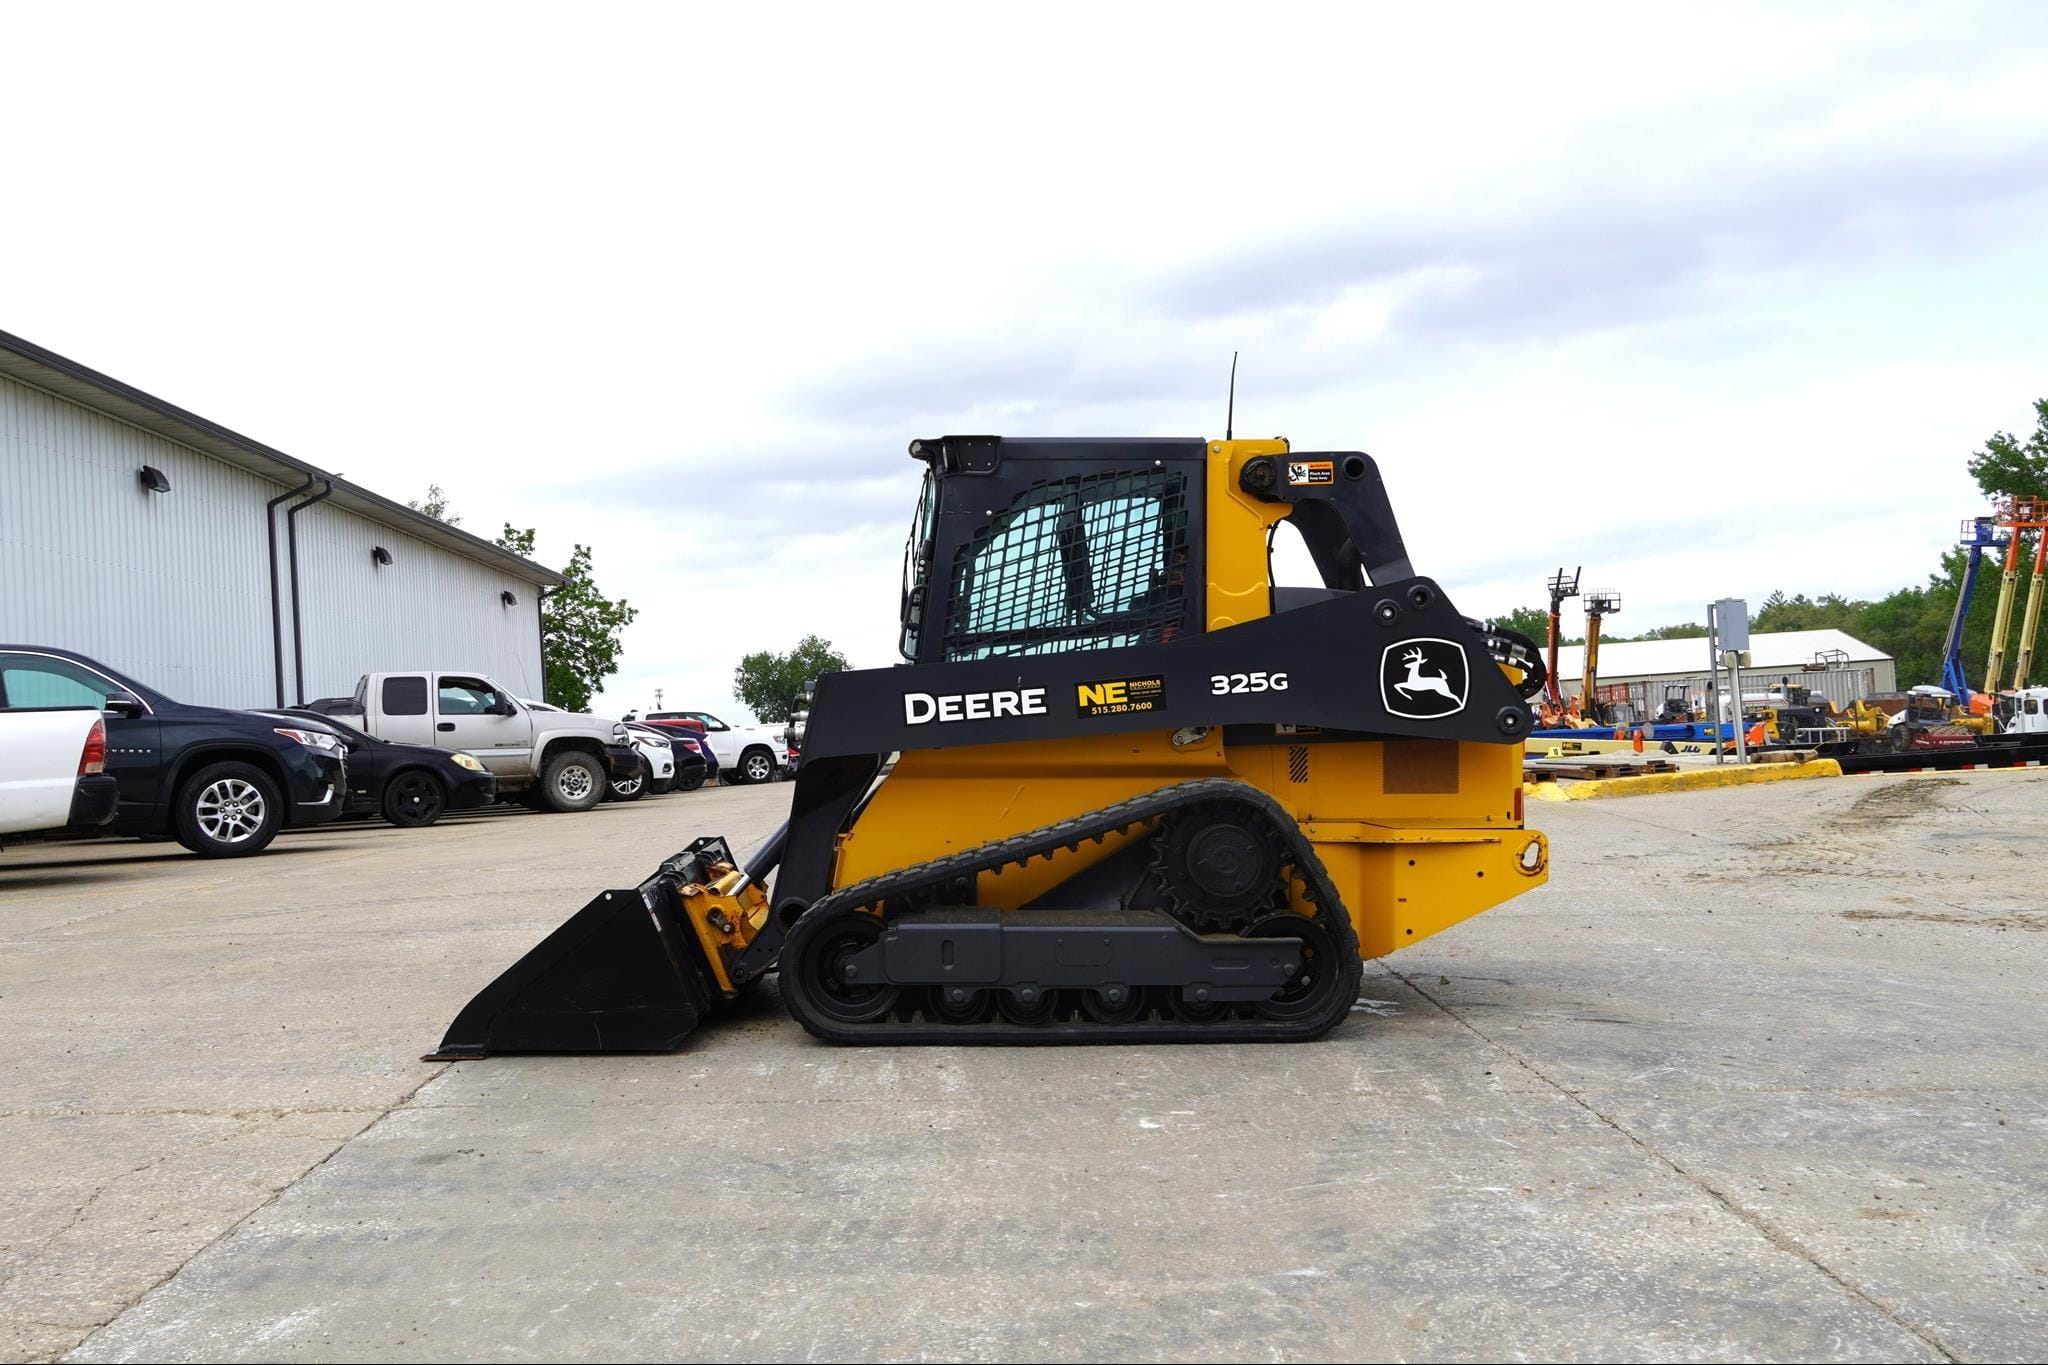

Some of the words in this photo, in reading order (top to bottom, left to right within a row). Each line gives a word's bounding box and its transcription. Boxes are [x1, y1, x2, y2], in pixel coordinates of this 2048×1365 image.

[1078, 681, 1128, 706] NE
[1210, 672, 1288, 695] 325G
[904, 688, 1047, 725] DEERE
[1091, 702, 1152, 715] 515.280.7600
[1680, 745, 1701, 754] JLG
